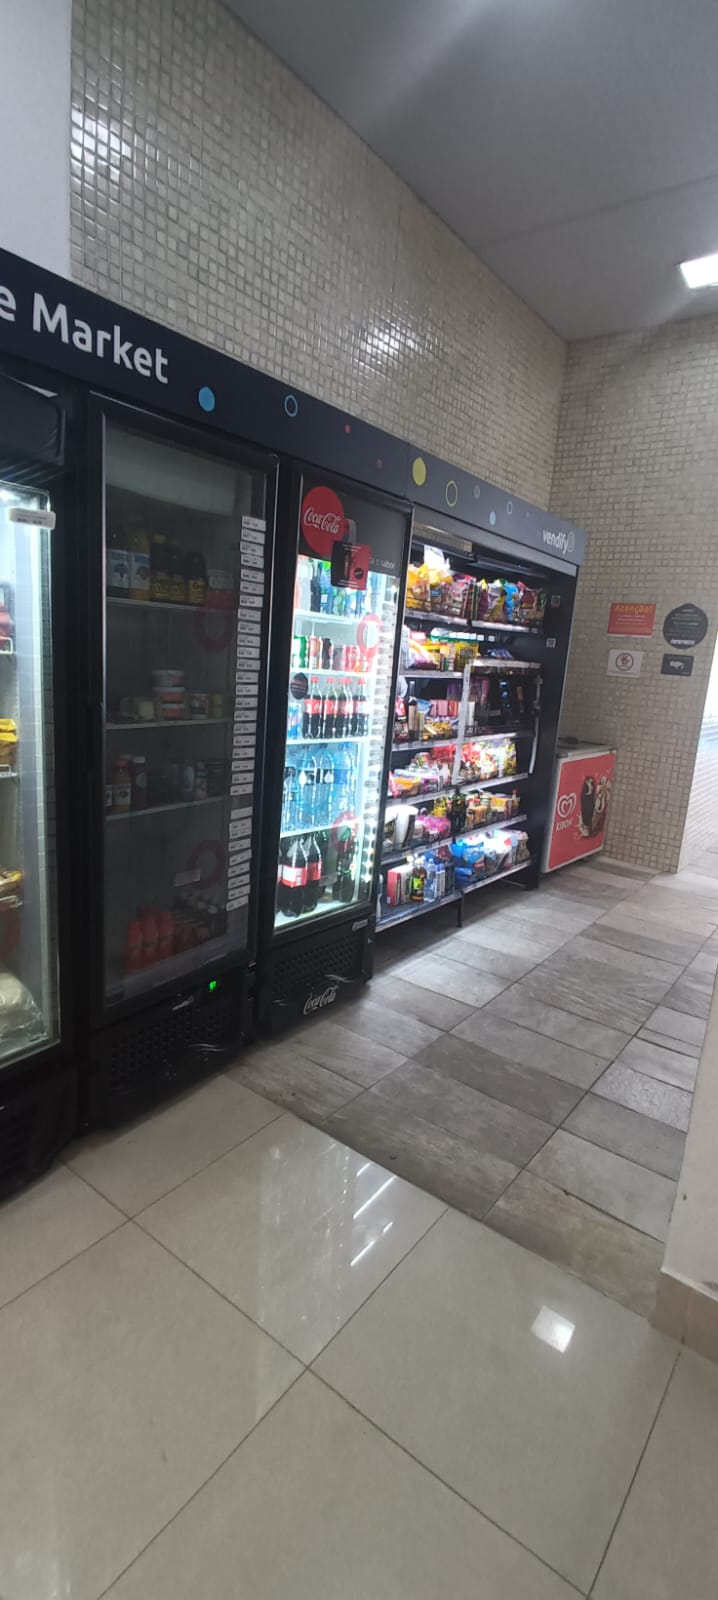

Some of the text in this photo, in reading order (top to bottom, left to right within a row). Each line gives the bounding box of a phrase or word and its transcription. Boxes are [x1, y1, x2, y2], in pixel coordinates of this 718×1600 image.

[33, 292, 169, 384] Market
[304, 507, 342, 534] Coca-Cola
[542, 529, 568, 554] vendify
[614, 604, 654, 615] Atenção!
[303, 985, 339, 1015] Coca-Cola
